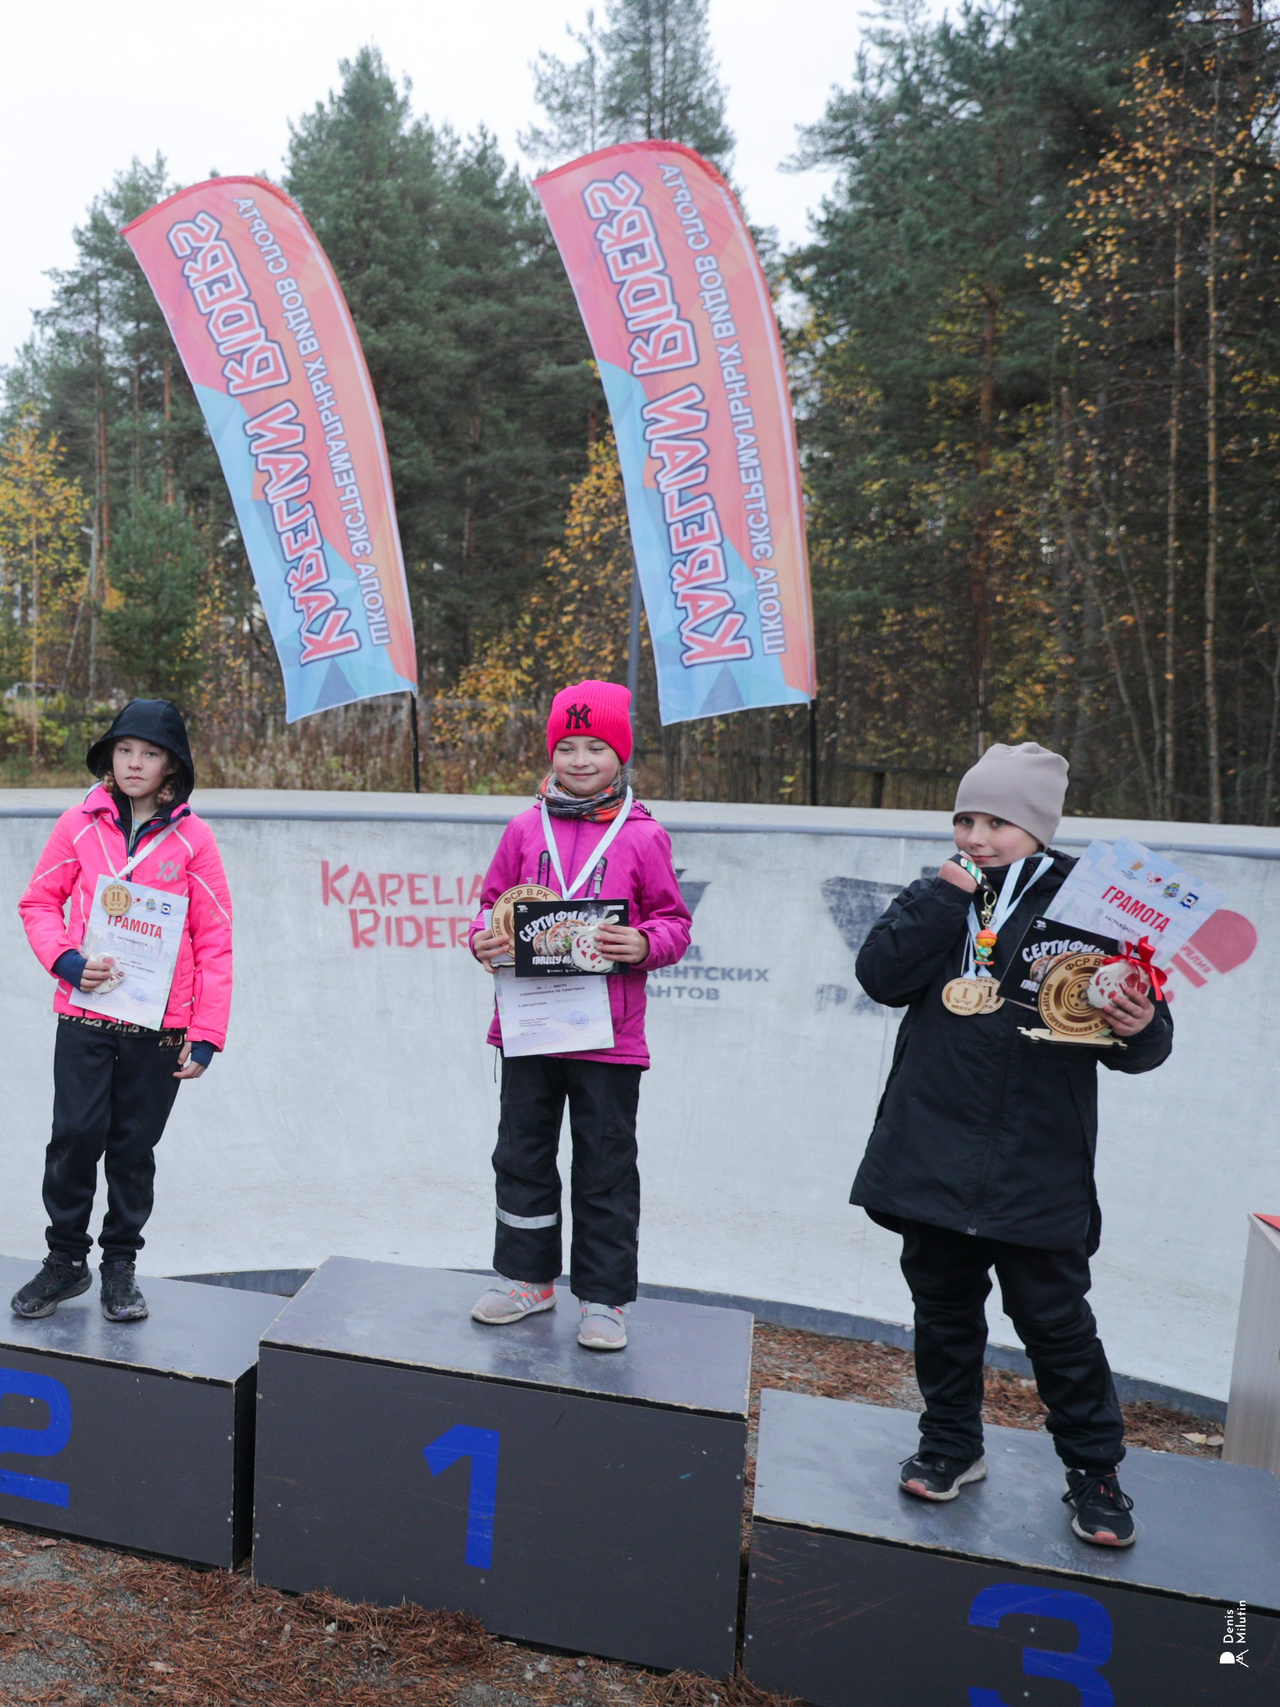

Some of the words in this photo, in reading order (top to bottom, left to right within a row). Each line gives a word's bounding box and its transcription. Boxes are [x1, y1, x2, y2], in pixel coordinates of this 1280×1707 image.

[503, 889, 523, 905] ФСР
[527, 888, 533, 896] В
[536, 890, 550, 900] РК
[1101, 885, 1171, 933] ГРАМОТА
[107, 914, 162, 938] ГРАМОТА
[1065, 957, 1090, 971] ФСР
[422, 1423, 500, 1570] 1
[968, 1583, 1115, 1707] 3
